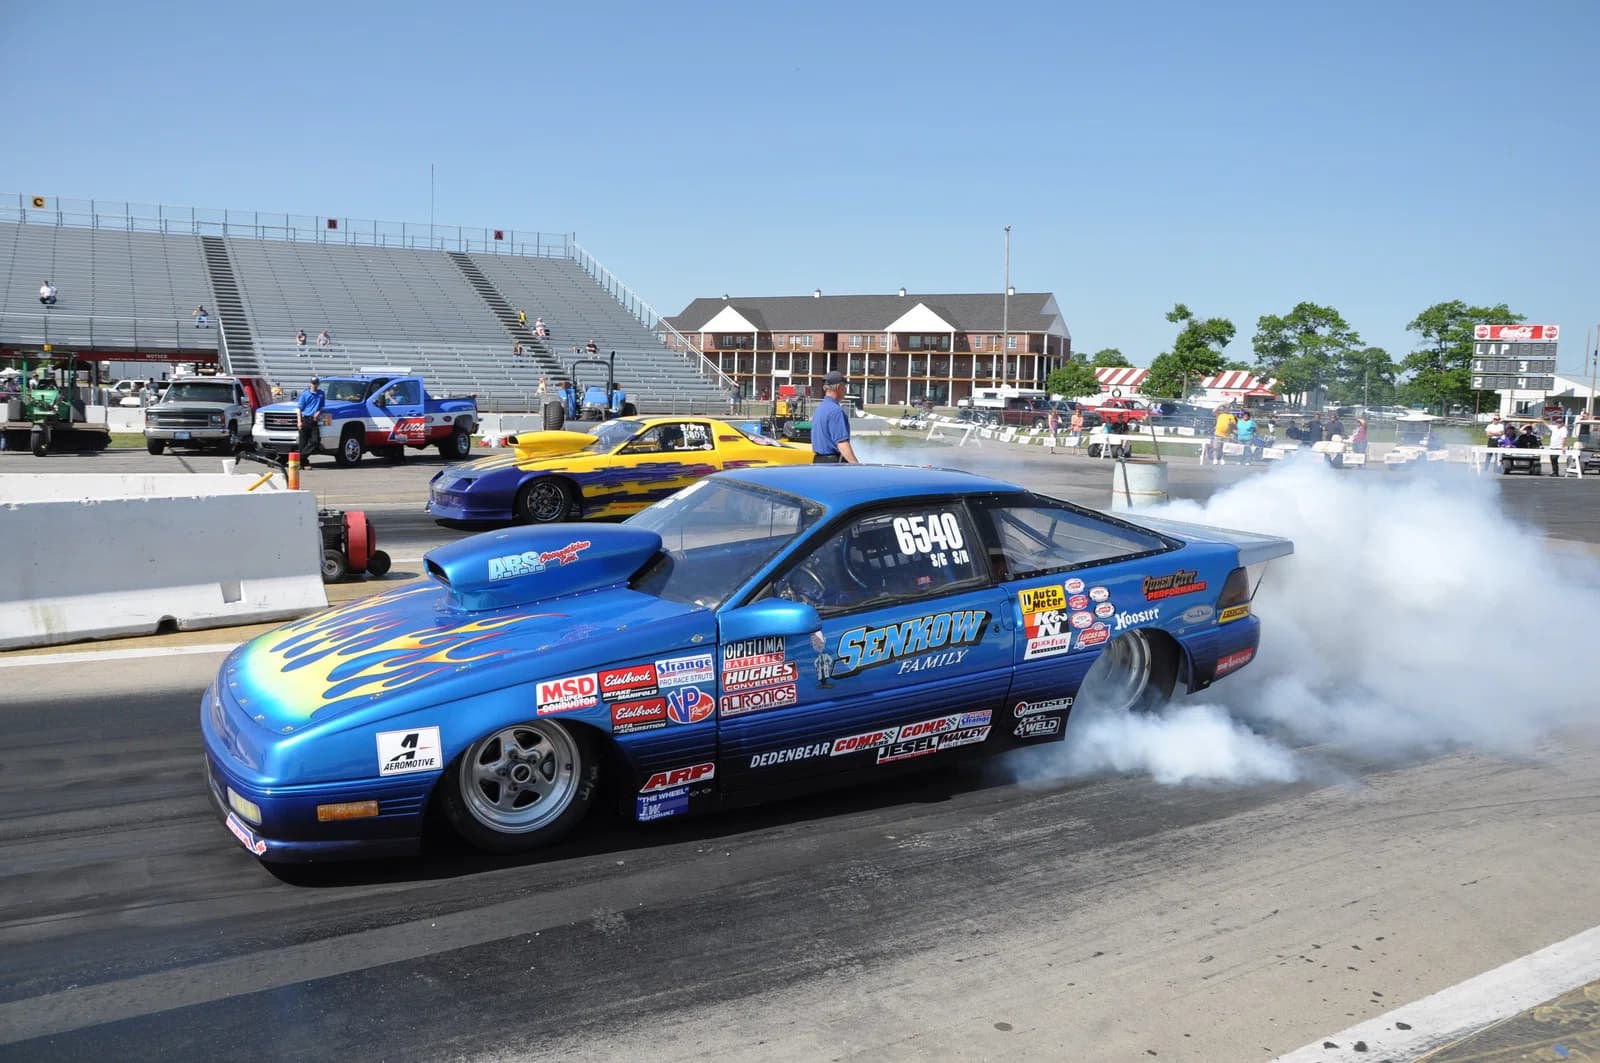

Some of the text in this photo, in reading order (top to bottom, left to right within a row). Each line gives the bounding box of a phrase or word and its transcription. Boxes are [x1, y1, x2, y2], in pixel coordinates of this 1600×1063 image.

[33, 197, 44, 208] C
[1475, 343, 1510, 355] LAP
[1473, 361, 1529, 372] 1 3
[1473, 377, 1527, 389] 2 4
[893, 512, 964, 555] 6540
[1033, 589, 1058, 600] Auto
[1032, 597, 1064, 611] Meter
[1115, 608, 1160, 630] Hoosier
[726, 637, 784, 659] OPTIMA
[831, 610, 992, 679] SENKOW
[657, 659, 712, 674] Strange
[725, 653, 784, 669] BATTERIES
[897, 649, 968, 675] FAMILY
[603, 670, 652, 687] Edelbrock
[725, 662, 794, 685] HUGHES
[542, 677, 595, 703] MSD
[725, 675, 793, 691] CONVERTERS
[615, 704, 662, 719] Edelbrock
[668, 686, 700, 723] VP
[901, 718, 947, 739] COMP
[1026, 720, 1057, 732] WELD
[834, 732, 884, 752] COMP
[750, 742, 831, 768] DEDENBEAR
[383, 757, 435, 771] AEROMOTIVE
[643, 763, 715, 791] ARP
